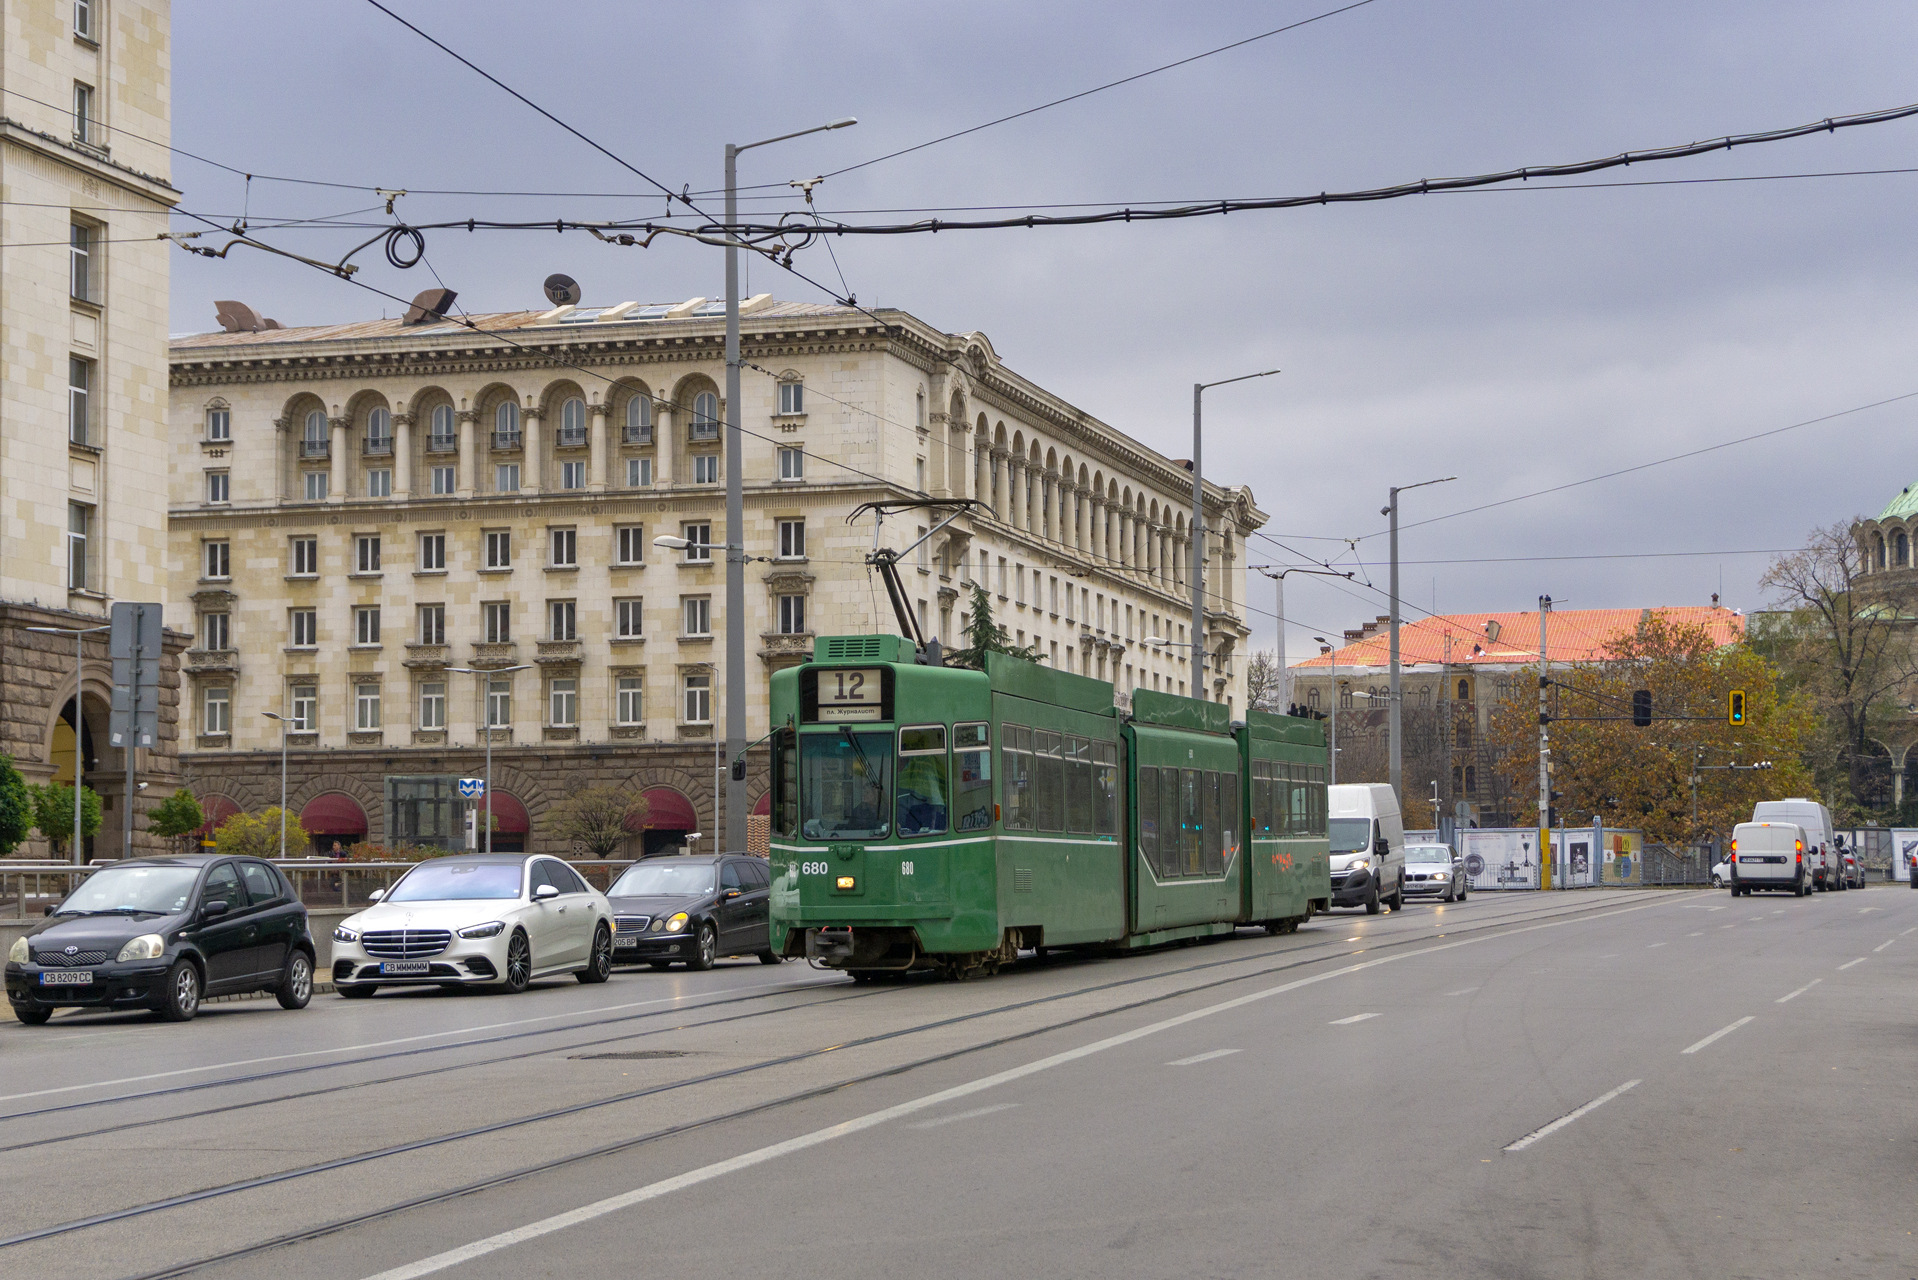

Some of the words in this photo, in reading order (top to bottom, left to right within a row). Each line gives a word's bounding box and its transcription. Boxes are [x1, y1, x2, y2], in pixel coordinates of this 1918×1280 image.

[834, 672, 864, 699] 12
[802, 862, 828, 875] 680
[901, 861, 914, 875] 680
[385, 963, 395, 972] CB
[45, 973, 56, 983] CB
[57, 973, 78, 983] 8209
[79, 972, 91, 982] CC
